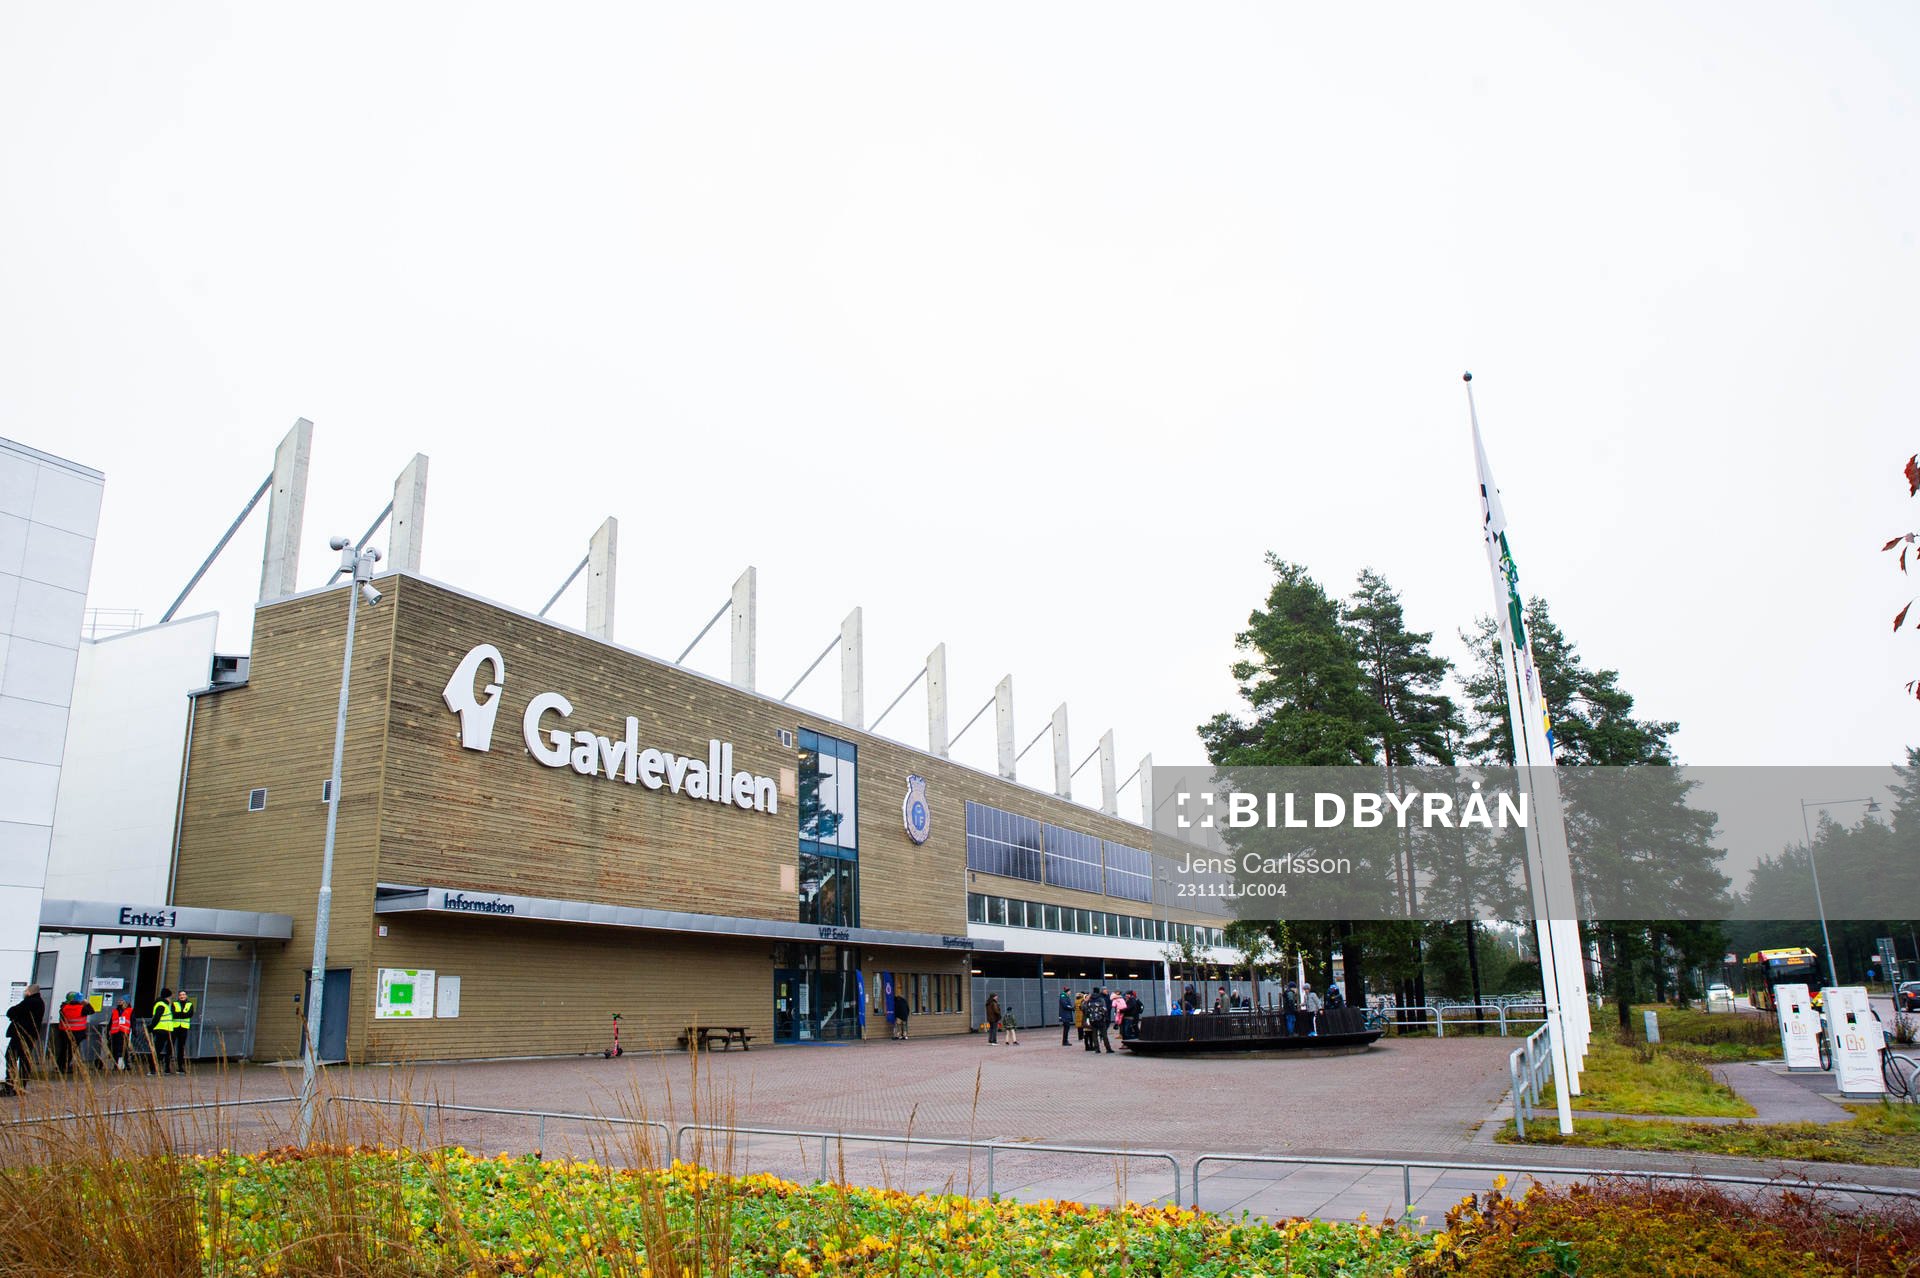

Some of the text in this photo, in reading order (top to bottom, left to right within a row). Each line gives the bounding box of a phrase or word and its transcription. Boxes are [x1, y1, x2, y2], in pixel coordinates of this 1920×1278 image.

[523, 692, 778, 814] Gavlevallen
[444, 892, 515, 914] Information
[119, 907, 176, 927] Entré 1
[818, 927, 831, 939] VIP
